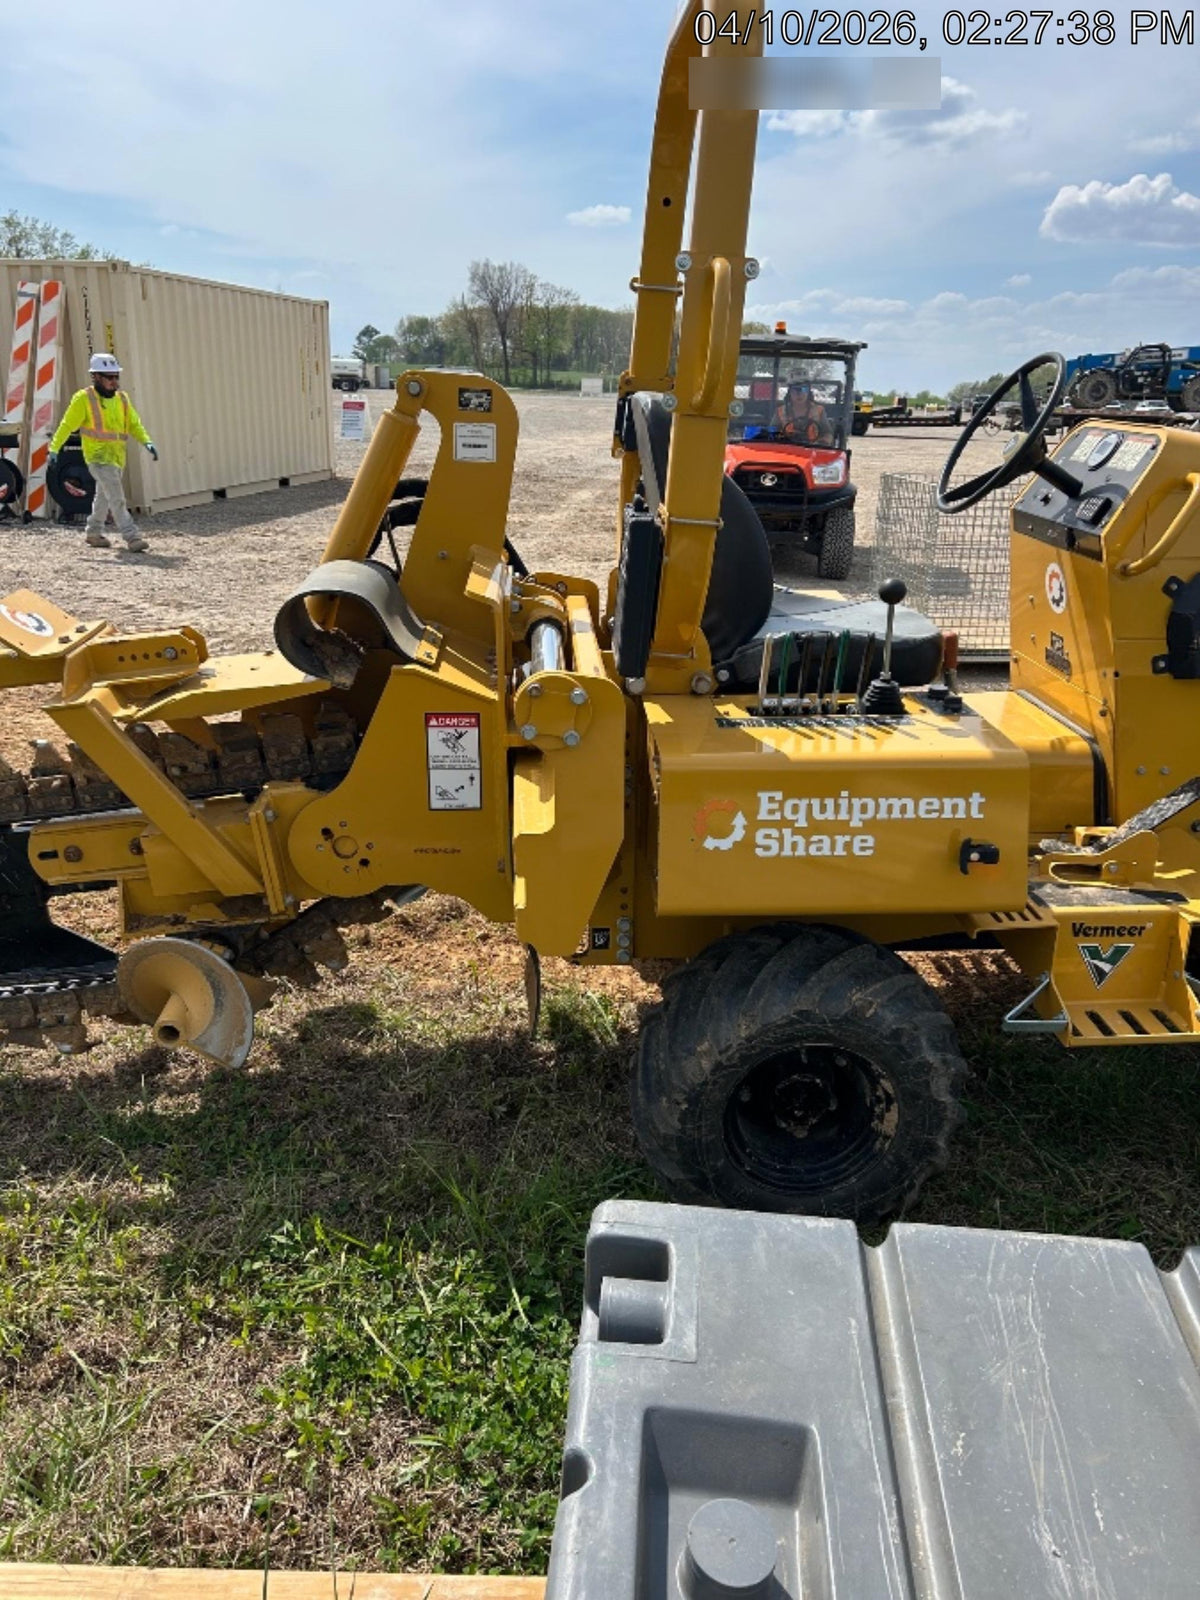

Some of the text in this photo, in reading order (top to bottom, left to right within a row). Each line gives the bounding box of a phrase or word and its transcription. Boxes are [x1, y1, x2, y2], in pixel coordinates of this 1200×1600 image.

[756, 790, 986, 828] Equipment
[755, 828, 875, 858] Share
[1071, 921, 1147, 938] Vermeer
